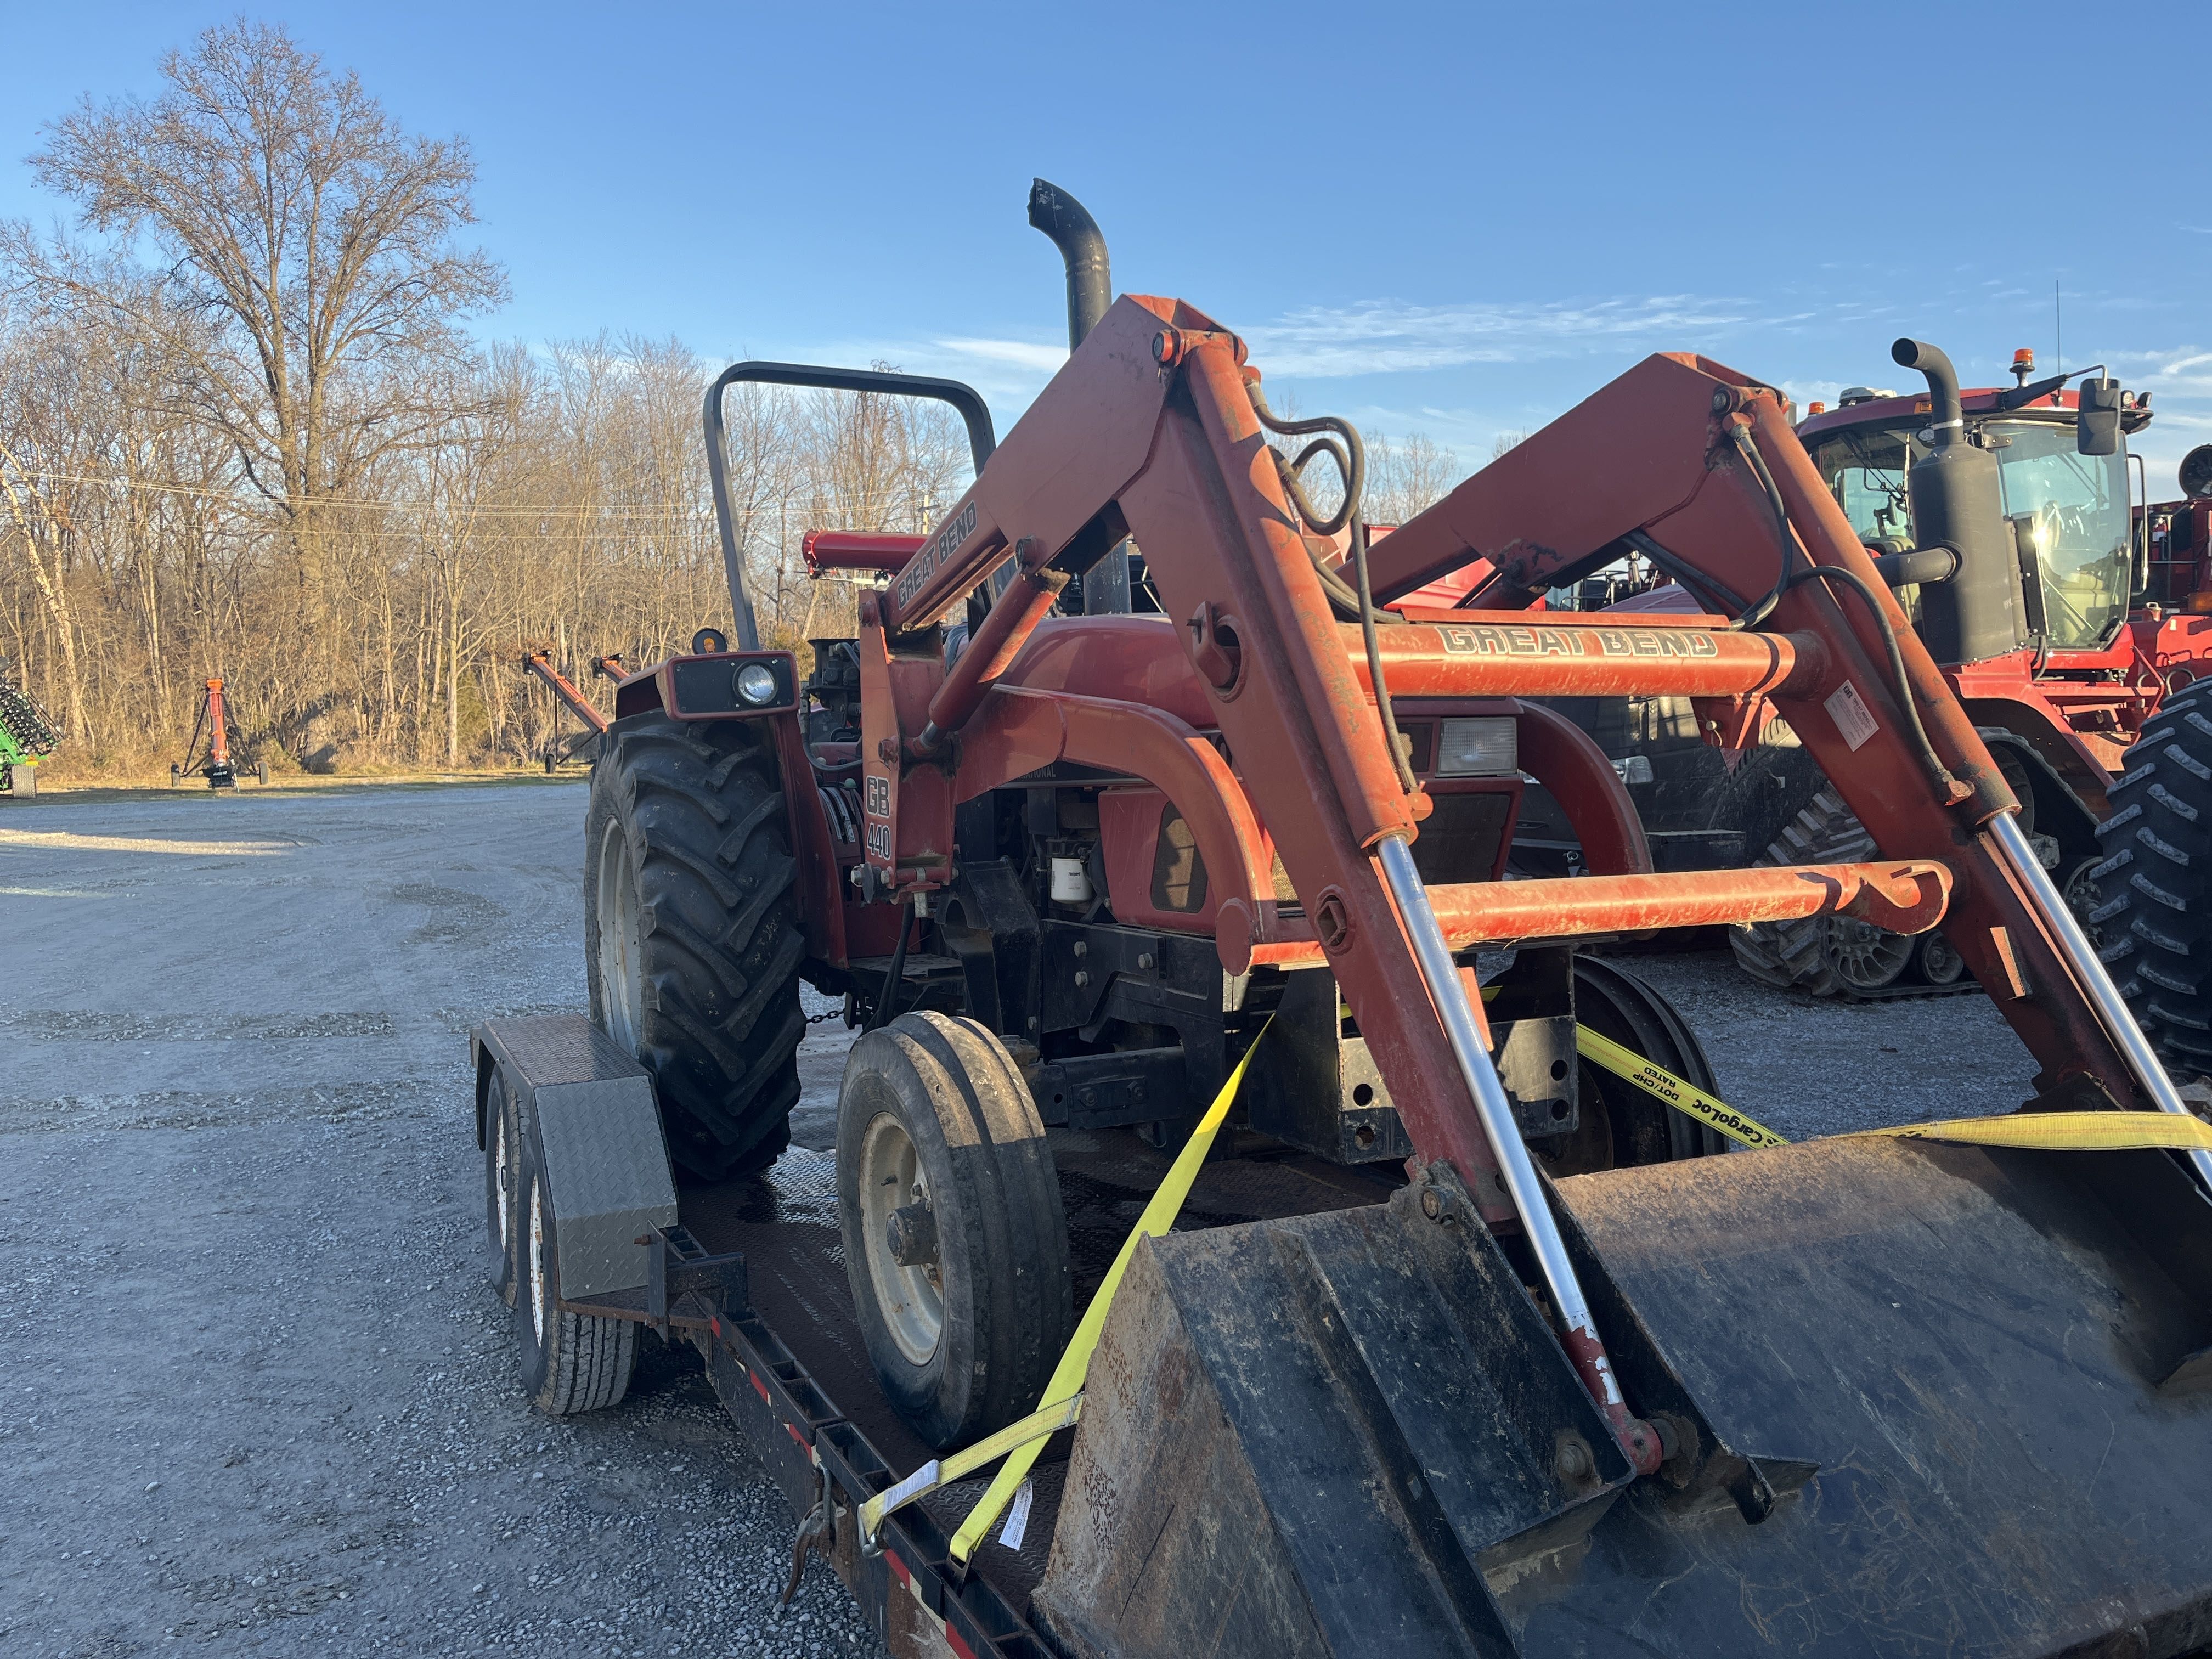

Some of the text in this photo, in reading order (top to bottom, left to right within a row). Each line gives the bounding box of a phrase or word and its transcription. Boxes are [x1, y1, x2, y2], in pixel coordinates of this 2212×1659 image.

[898, 500, 977, 610] GREAT BEND
[1435, 625, 1718, 658] GREAT BEND
[866, 775, 890, 818] GB
[867, 822, 891, 861] 440
[1632, 1073, 1679, 1101] DOT/CHP
[1644, 1066, 1677, 1088] RATED
[1692, 1099, 1763, 1144] CargoLoc
